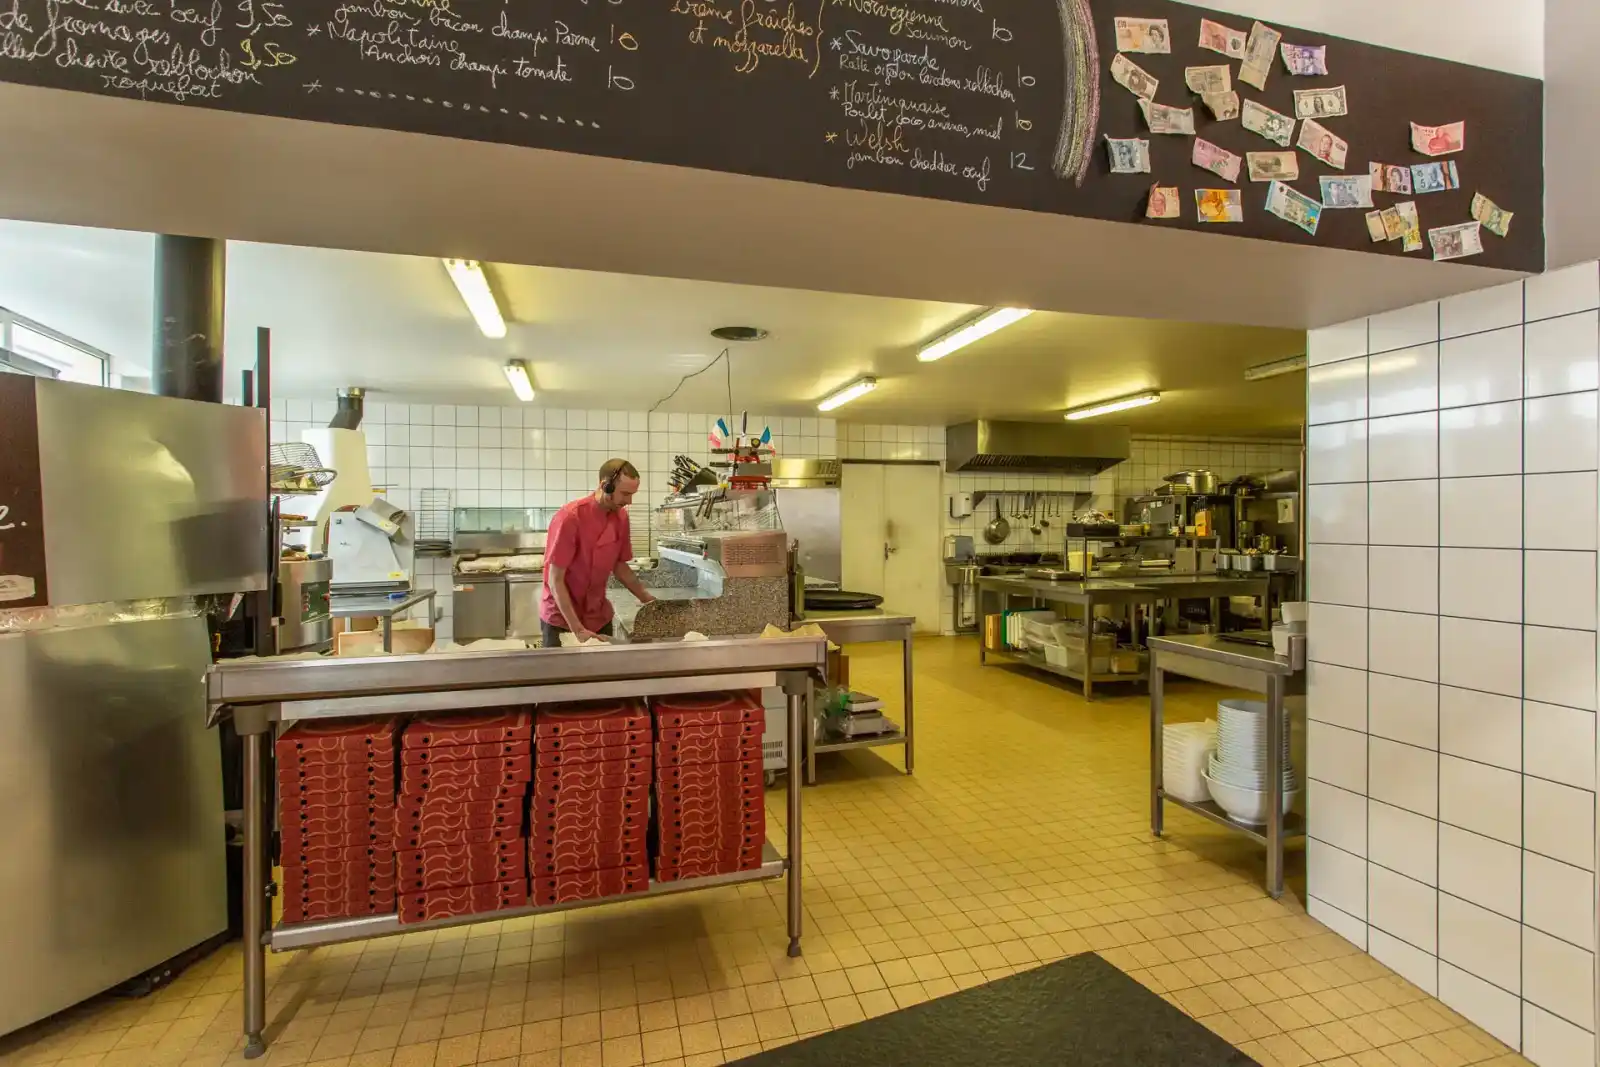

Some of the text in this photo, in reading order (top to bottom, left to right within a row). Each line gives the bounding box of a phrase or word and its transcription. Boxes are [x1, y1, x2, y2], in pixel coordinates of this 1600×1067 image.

[429, 8, 483, 33] bacon
[554, 20, 600, 52] Parme
[610, 24, 639, 50] 10
[688, 19, 709, 45] et
[905, 21, 973, 51] Saumon
[512, 55, 573, 82] tomate
[607, 64, 635, 90] 10
[1017, 65, 1037, 88] 10
[1015, 110, 1033, 131] 10
[846, 119, 910, 153] Welsh
[1010, 151, 1035, 170] 12
